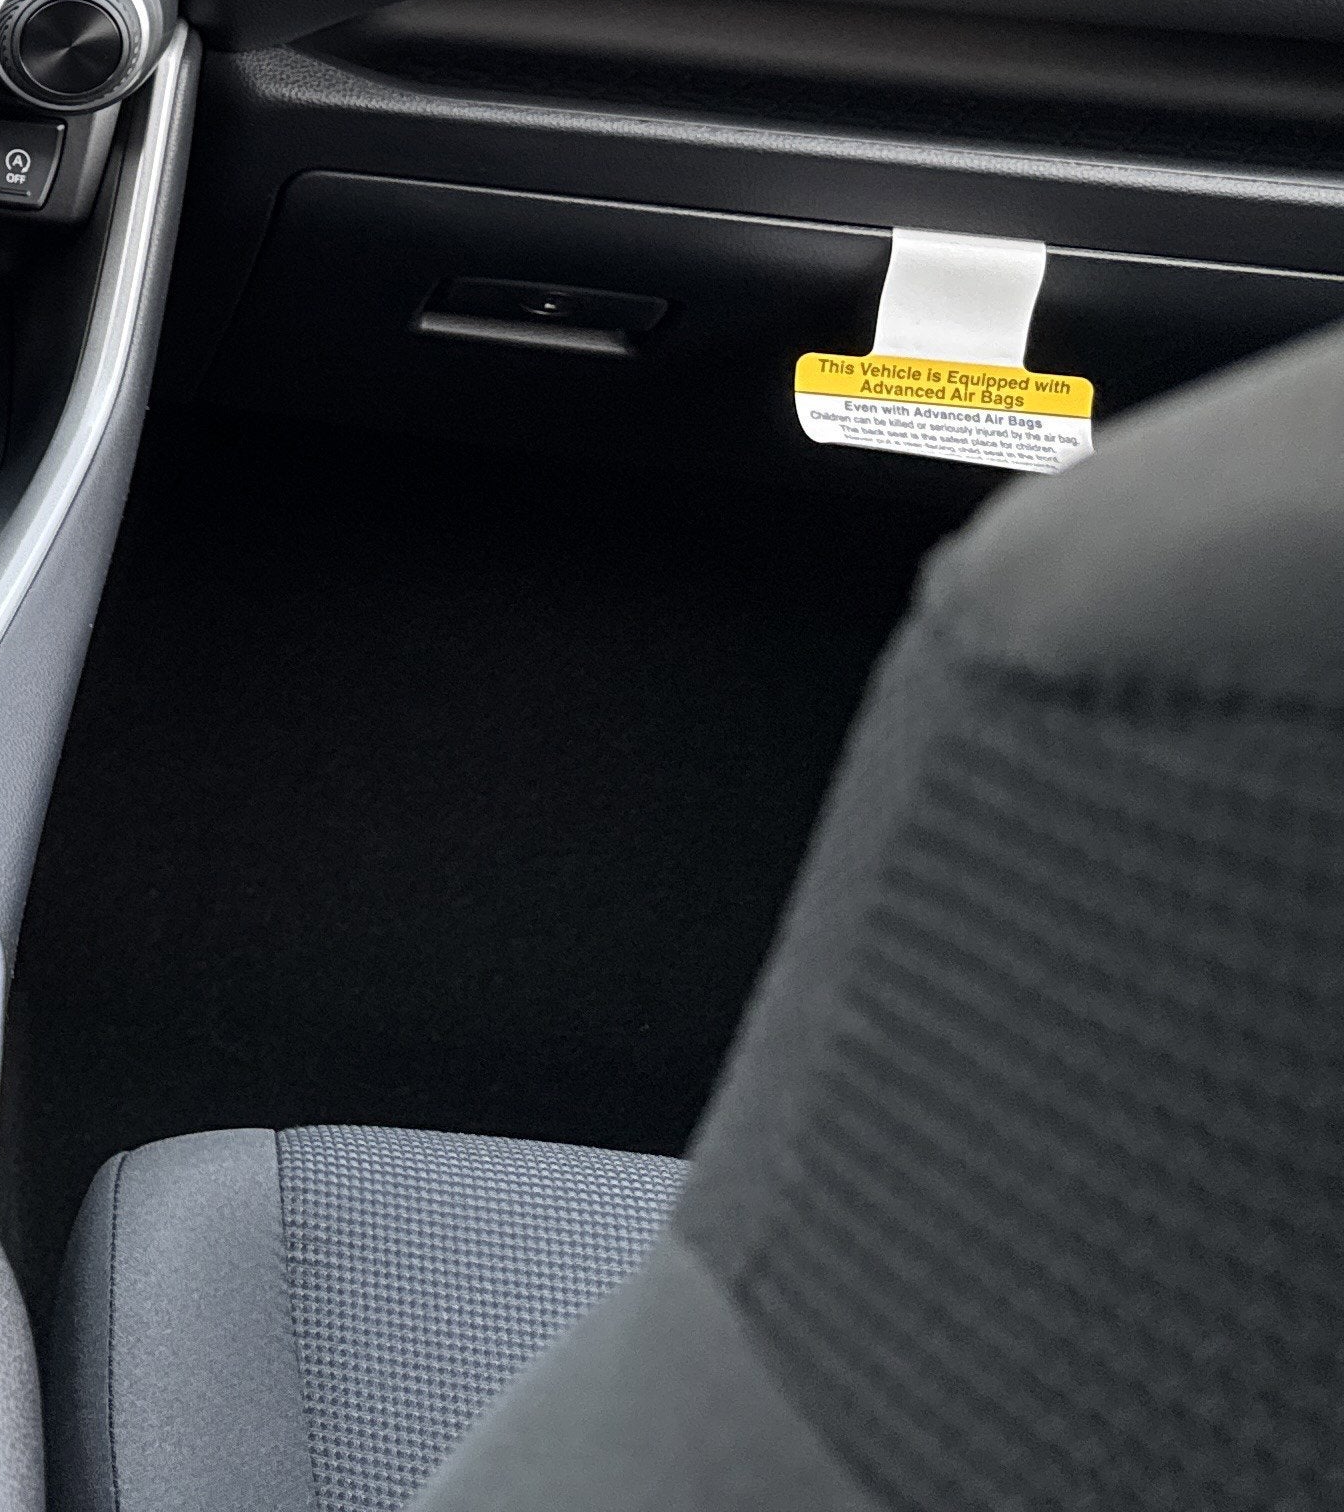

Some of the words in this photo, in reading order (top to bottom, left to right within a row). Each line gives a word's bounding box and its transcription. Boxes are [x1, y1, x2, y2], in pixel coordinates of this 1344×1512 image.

[5, 172, 26, 185] OFF
[818, 358, 855, 375] This
[860, 362, 922, 381] Vehicle
[926, 367, 942, 383] is
[947, 370, 1030, 391] Equipped
[1034, 378, 1071, 395] with
[860, 379, 946, 400] Advanced
[950, 386, 976, 403] Air
[981, 390, 1025, 409] Bags
[810, 410, 852, 423] Children
[853, 416, 871, 425] can
[873, 416, 887, 427] be
[889, 418, 915, 429] killed
[929, 423, 973, 436] seriously
[975, 426, 1009, 439] injured
[1011, 430, 1023, 441] by
[1025, 432, 1041, 442] the
[1044, 433, 1057, 443] air
[844, 400, 878, 414] Even
[881, 404, 910, 417] with
[913, 407, 981, 423] Advanced
[984, 413, 1005, 426] Air
[1008, 416, 1043, 430] Bags
